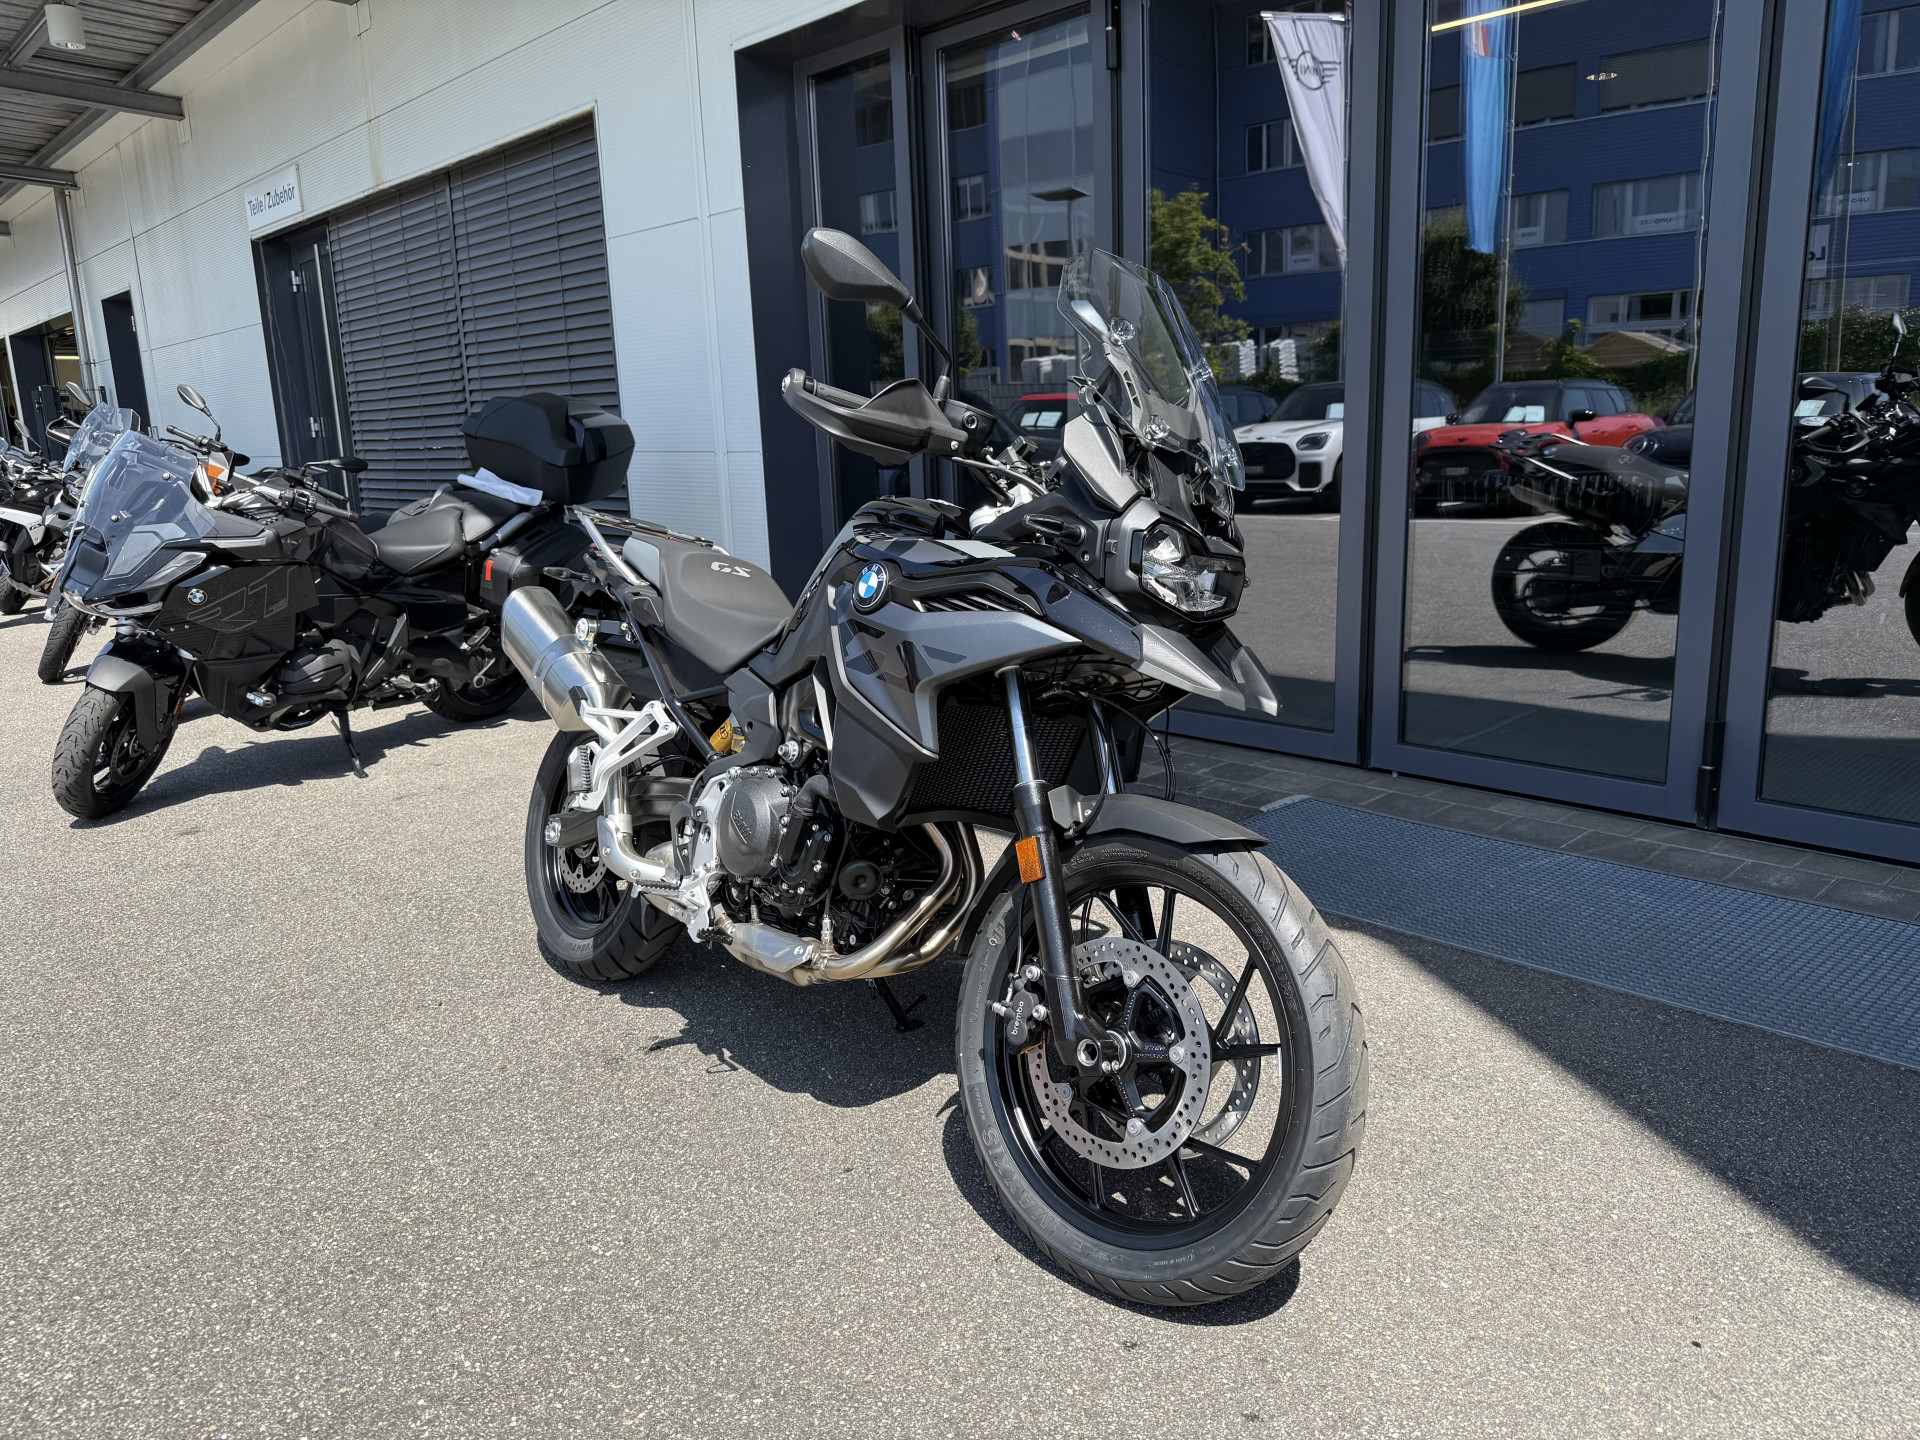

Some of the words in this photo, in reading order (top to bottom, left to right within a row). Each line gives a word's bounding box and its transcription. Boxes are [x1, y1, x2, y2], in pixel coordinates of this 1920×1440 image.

[248, 196, 264, 217] Teile
[267, 182, 295, 209] Zubehör
[710, 561, 752, 578] GS
[1011, 1000, 1025, 1036] brembo
[982, 1127, 1056, 1229] MAXXIS
